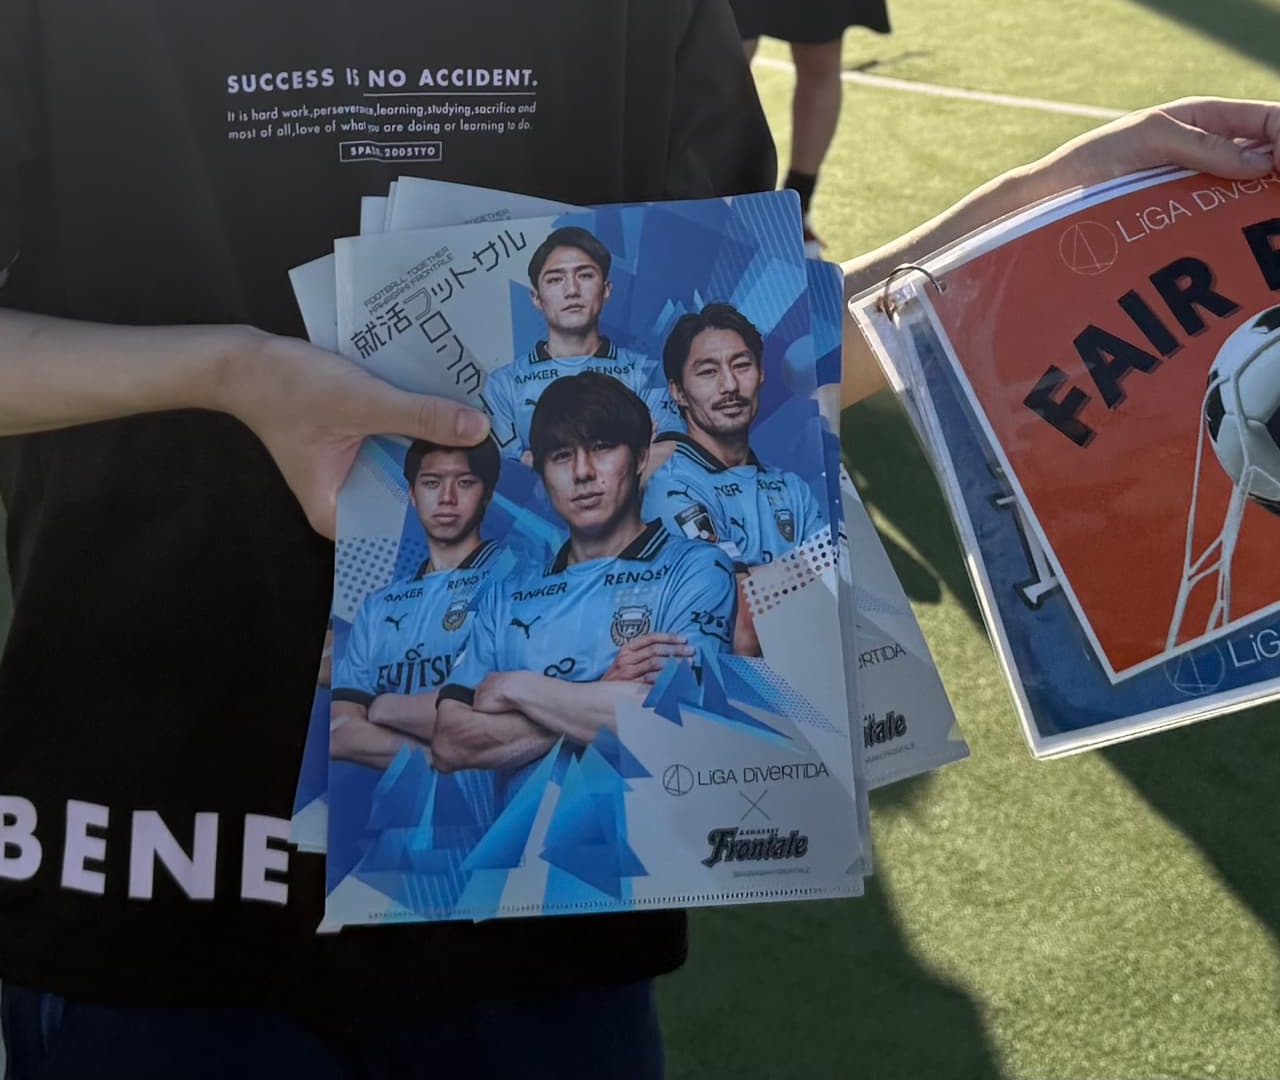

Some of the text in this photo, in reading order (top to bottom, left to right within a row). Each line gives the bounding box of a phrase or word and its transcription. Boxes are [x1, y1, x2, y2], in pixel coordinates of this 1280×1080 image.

[226, 68, 335, 94] SUCCESS
[368, 69, 407, 88] NO
[418, 68, 539, 87] ACCIDENT.
[227, 111, 235, 123] It
[239, 109, 249, 122] is
[251, 106, 279, 121] hard
[518, 101, 537, 114] and
[228, 128, 257, 141] most
[260, 123, 273, 138] of
[325, 119, 337, 133] of
[340, 118, 367, 132] what
[383, 123, 404, 133] are
[407, 119, 441, 134] doing
[444, 122, 457, 132] or
[460, 118, 505, 134] learning
[507, 120, 516, 130] to
[363, 245, 450, 307] FOOTBALL TOGETHER
[410, 252, 455, 287] FRONTALE
[1022, 255, 1243, 449] FAIR
[514, 368, 560, 385] ANKER
[511, 564, 670, 602] ANKER RENOSY
[700, 825, 810, 869] Frontale
